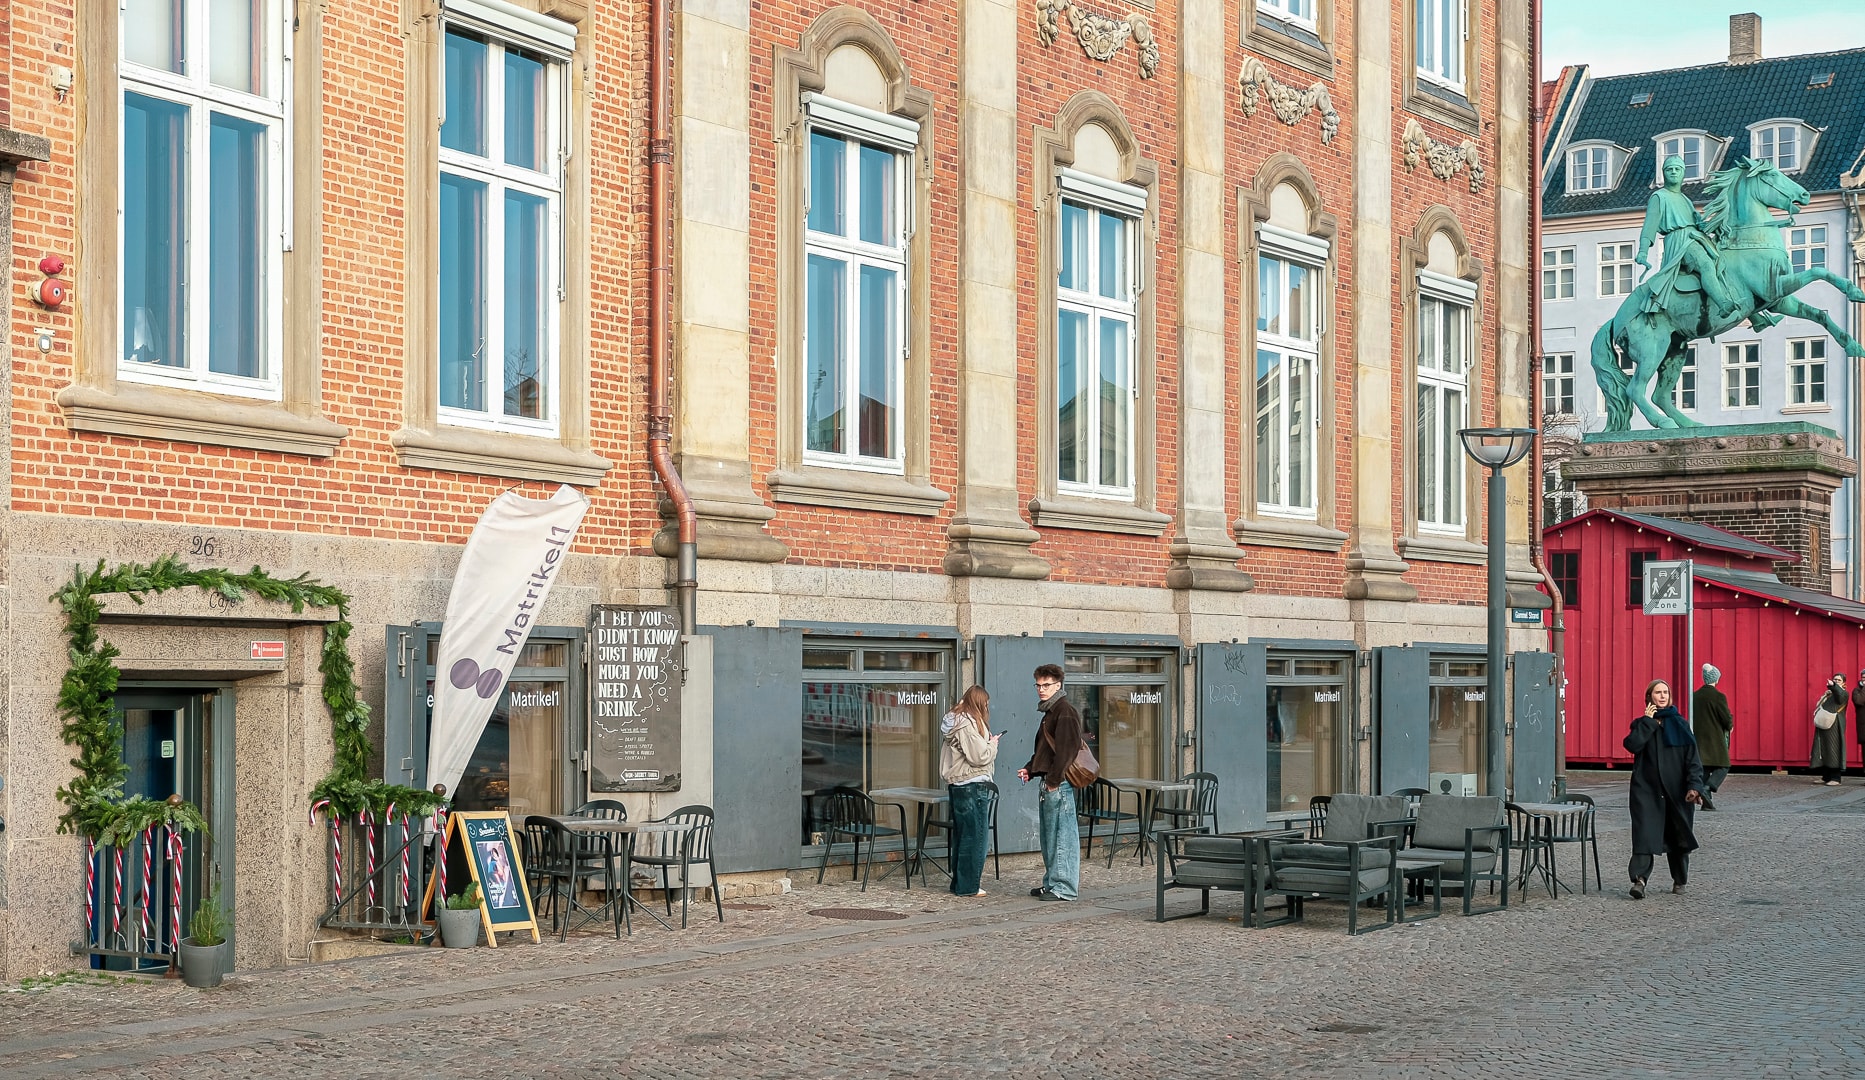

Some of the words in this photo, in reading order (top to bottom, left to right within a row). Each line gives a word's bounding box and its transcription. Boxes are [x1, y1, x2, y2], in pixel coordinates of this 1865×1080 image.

[190, 535, 215, 557] 26
[496, 525, 571, 655] Matrikel1
[600, 610, 605, 626] I
[612, 611, 634, 626] BET
[639, 611, 661, 626] YOU
[598, 628, 640, 645] DIDN'T
[643, 629, 679, 645] KNOW
[598, 646, 628, 662] JUST
[632, 647, 659, 663] HOW
[598, 664, 630, 680] MUCH
[636, 665, 659, 681] YOU
[511, 690, 559, 707] Matrikel1
[598, 682, 628, 699] NEED
[632, 683, 642, 699] A
[897, 691, 937, 705] Matrikel1
[1130, 691, 1162, 704] Matrikel1
[1314, 691, 1340, 703] Matrikel1
[598, 700, 641, 717] DRINK.
